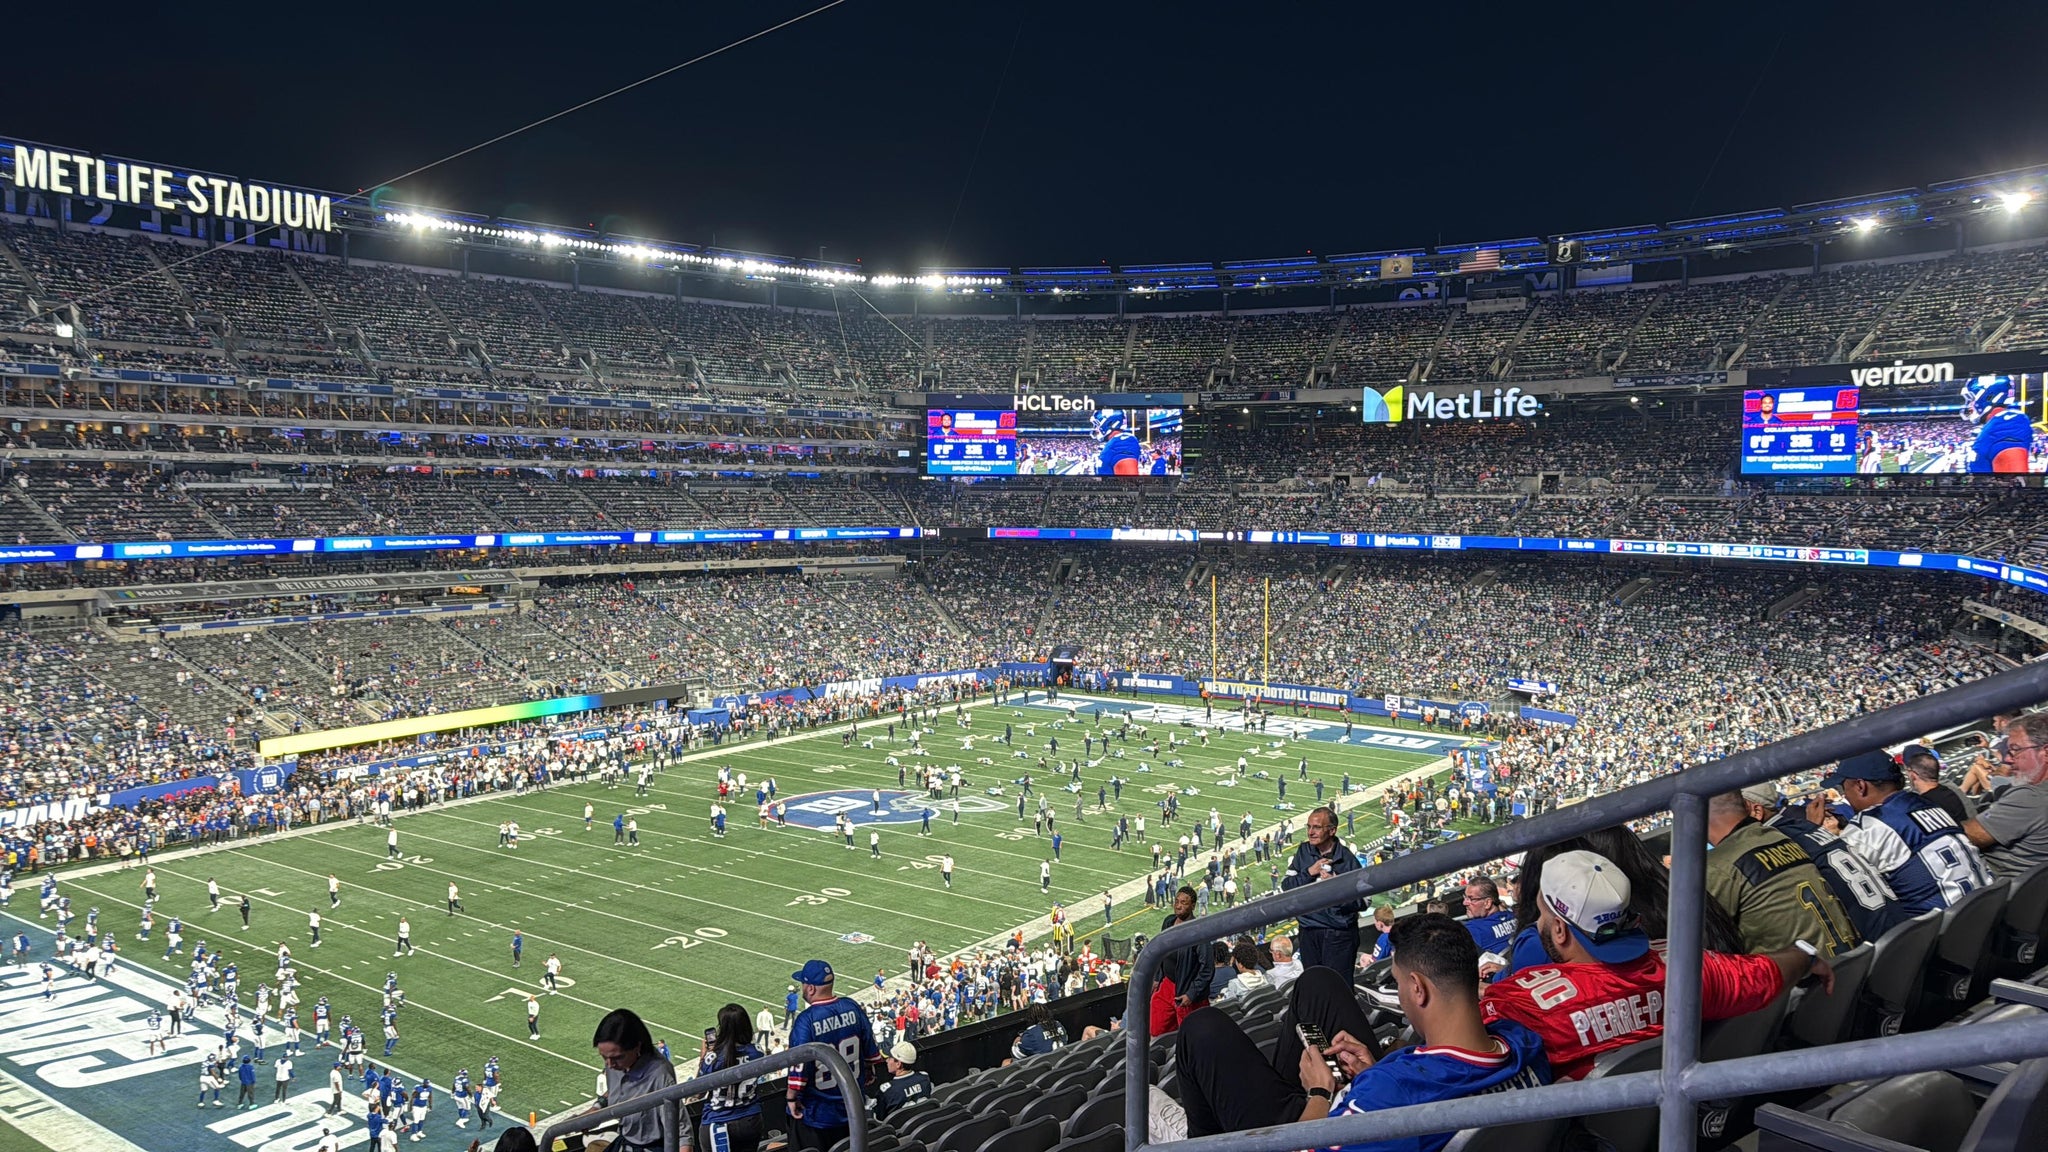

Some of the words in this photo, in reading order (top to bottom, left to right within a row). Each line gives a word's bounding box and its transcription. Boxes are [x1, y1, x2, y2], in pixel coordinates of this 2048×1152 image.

[14, 145, 175, 210] METLIFE
[185, 174, 332, 232] STADIUM
[1851, 361, 1954, 387] verizon
[1013, 395, 1095, 411] HCLTech
[1407, 386, 1539, 420] MetLife
[136, 589, 183, 597] MetLife
[275, 580, 324, 591] METLIFE
[325, 577, 378, 588] STADIUM
[824, 678, 882, 700] GIANTS
[1205, 681, 1228, 693] NEW
[1231, 683, 1257, 697] YORK
[1258, 686, 1308, 701] FOOTBALL
[1309, 690, 1348, 706] GIANTS
[375, 855, 434, 871] 20
[795, 887, 852, 906] 30
[664, 927, 728, 949] 20
[813, 1011, 857, 1036] BAVARO
[904, 1083, 923, 1098] LAMB
